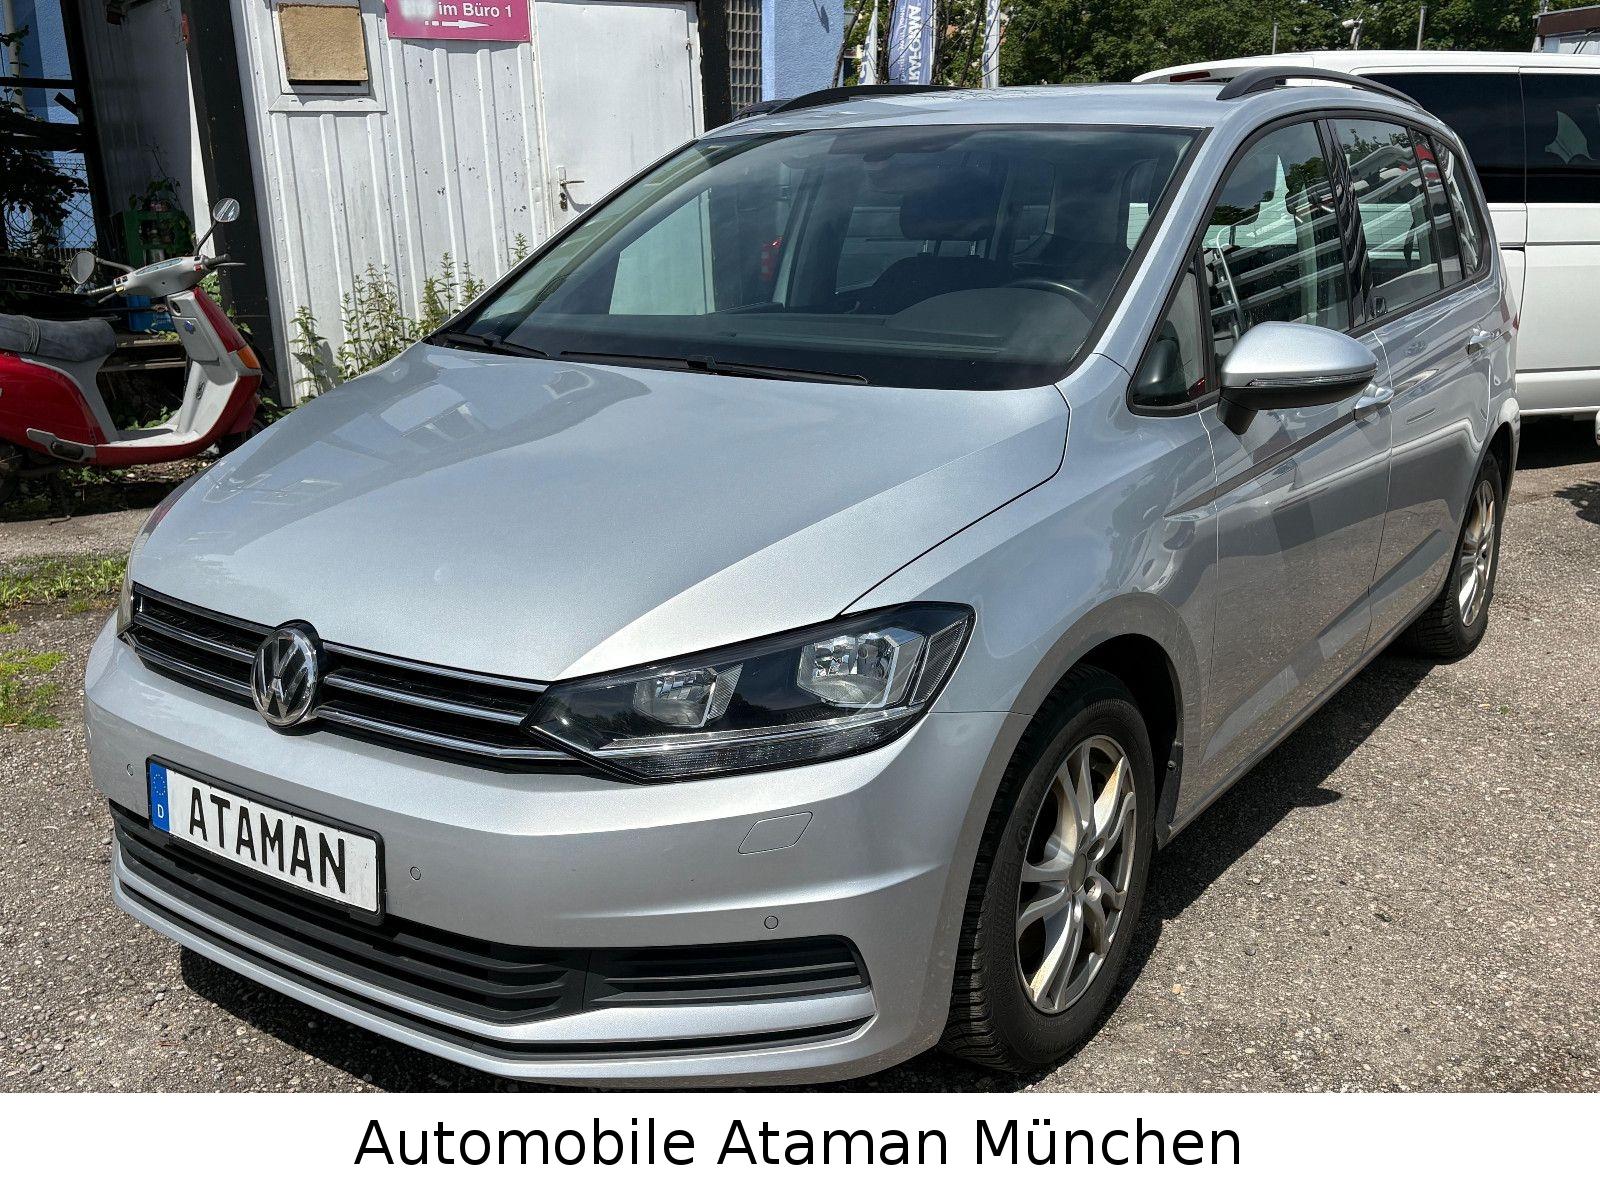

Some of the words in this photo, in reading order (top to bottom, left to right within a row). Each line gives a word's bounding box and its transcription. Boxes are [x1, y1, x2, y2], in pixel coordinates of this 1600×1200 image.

[438, 2, 458, 16] im
[463, 3, 500, 18] Büro
[505, 5, 513, 18] 1
[156, 803, 165, 820] D
[188, 786, 346, 894] ATAMAN
